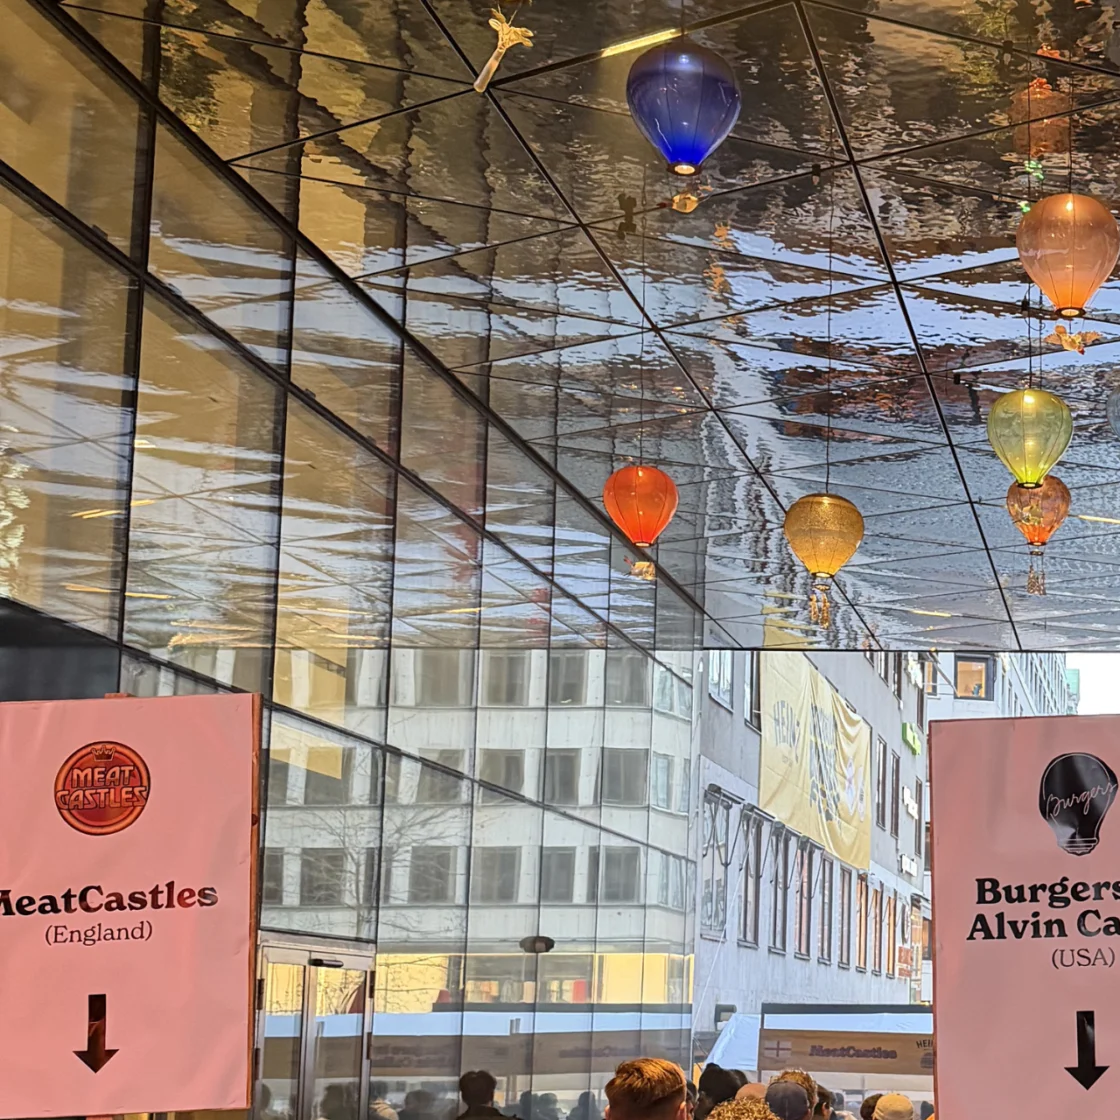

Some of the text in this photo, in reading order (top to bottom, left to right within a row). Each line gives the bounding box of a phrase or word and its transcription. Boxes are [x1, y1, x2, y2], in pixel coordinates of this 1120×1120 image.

[71, 765, 135, 788] MEAT
[56, 785, 149, 810] CASTLES
[1046, 782, 1118, 820] Burgers
[45, 920, 153, 947] (England)
[966, 911, 1068, 940] Alvin
[1052, 947, 1116, 970] (USA)
